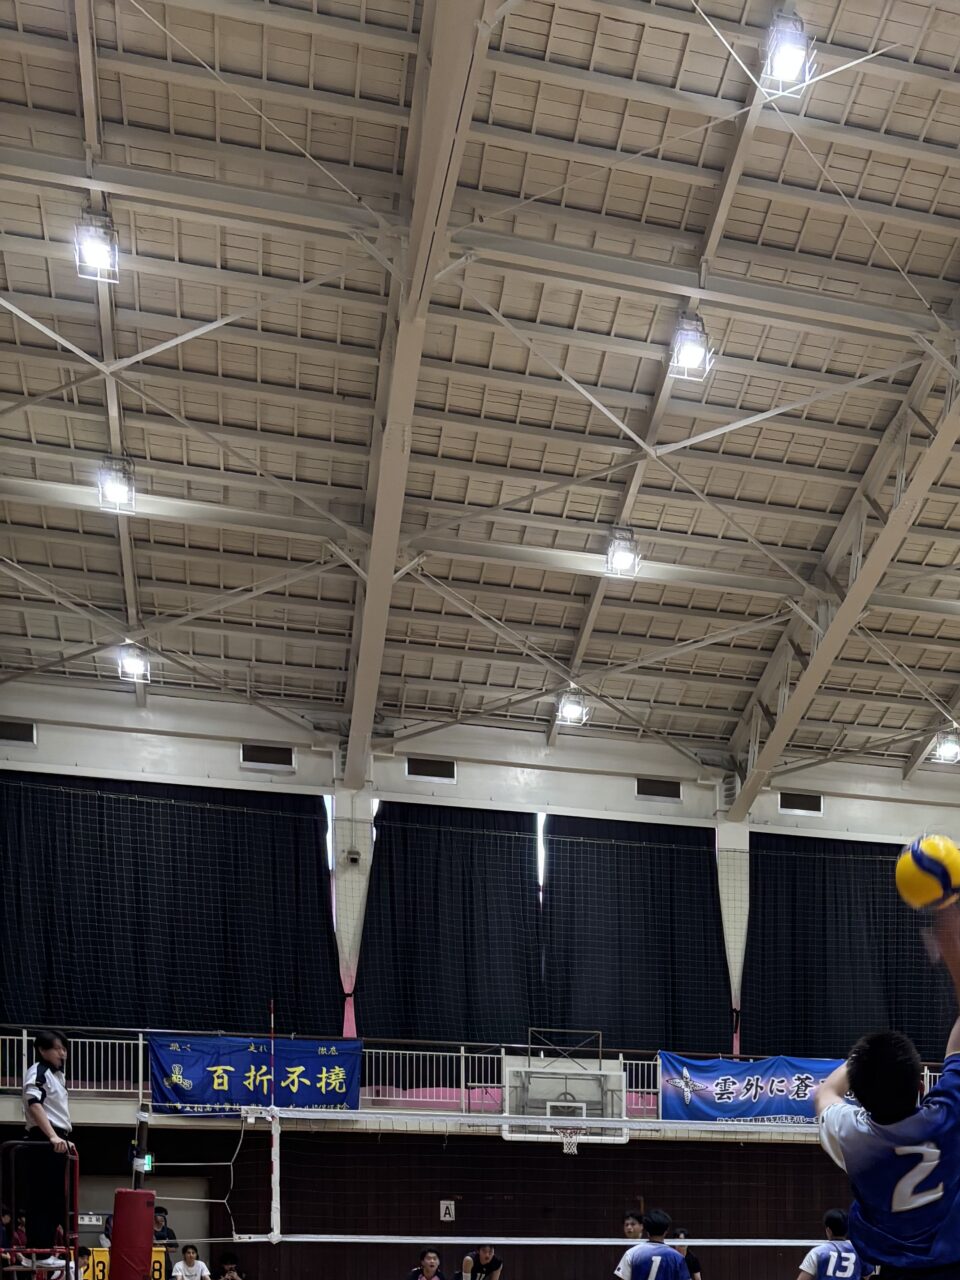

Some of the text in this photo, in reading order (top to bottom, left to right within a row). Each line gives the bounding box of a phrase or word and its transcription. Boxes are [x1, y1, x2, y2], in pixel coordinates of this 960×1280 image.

[206, 1065, 347, 1095] 百折不撓
[713, 1073, 827, 1103] 雲外に蒼
[891, 1142, 945, 1213] 2
[443, 1206, 451, 1218] A
[152, 1260, 162, 1280] 8
[826, 1252, 856, 1278] 13
